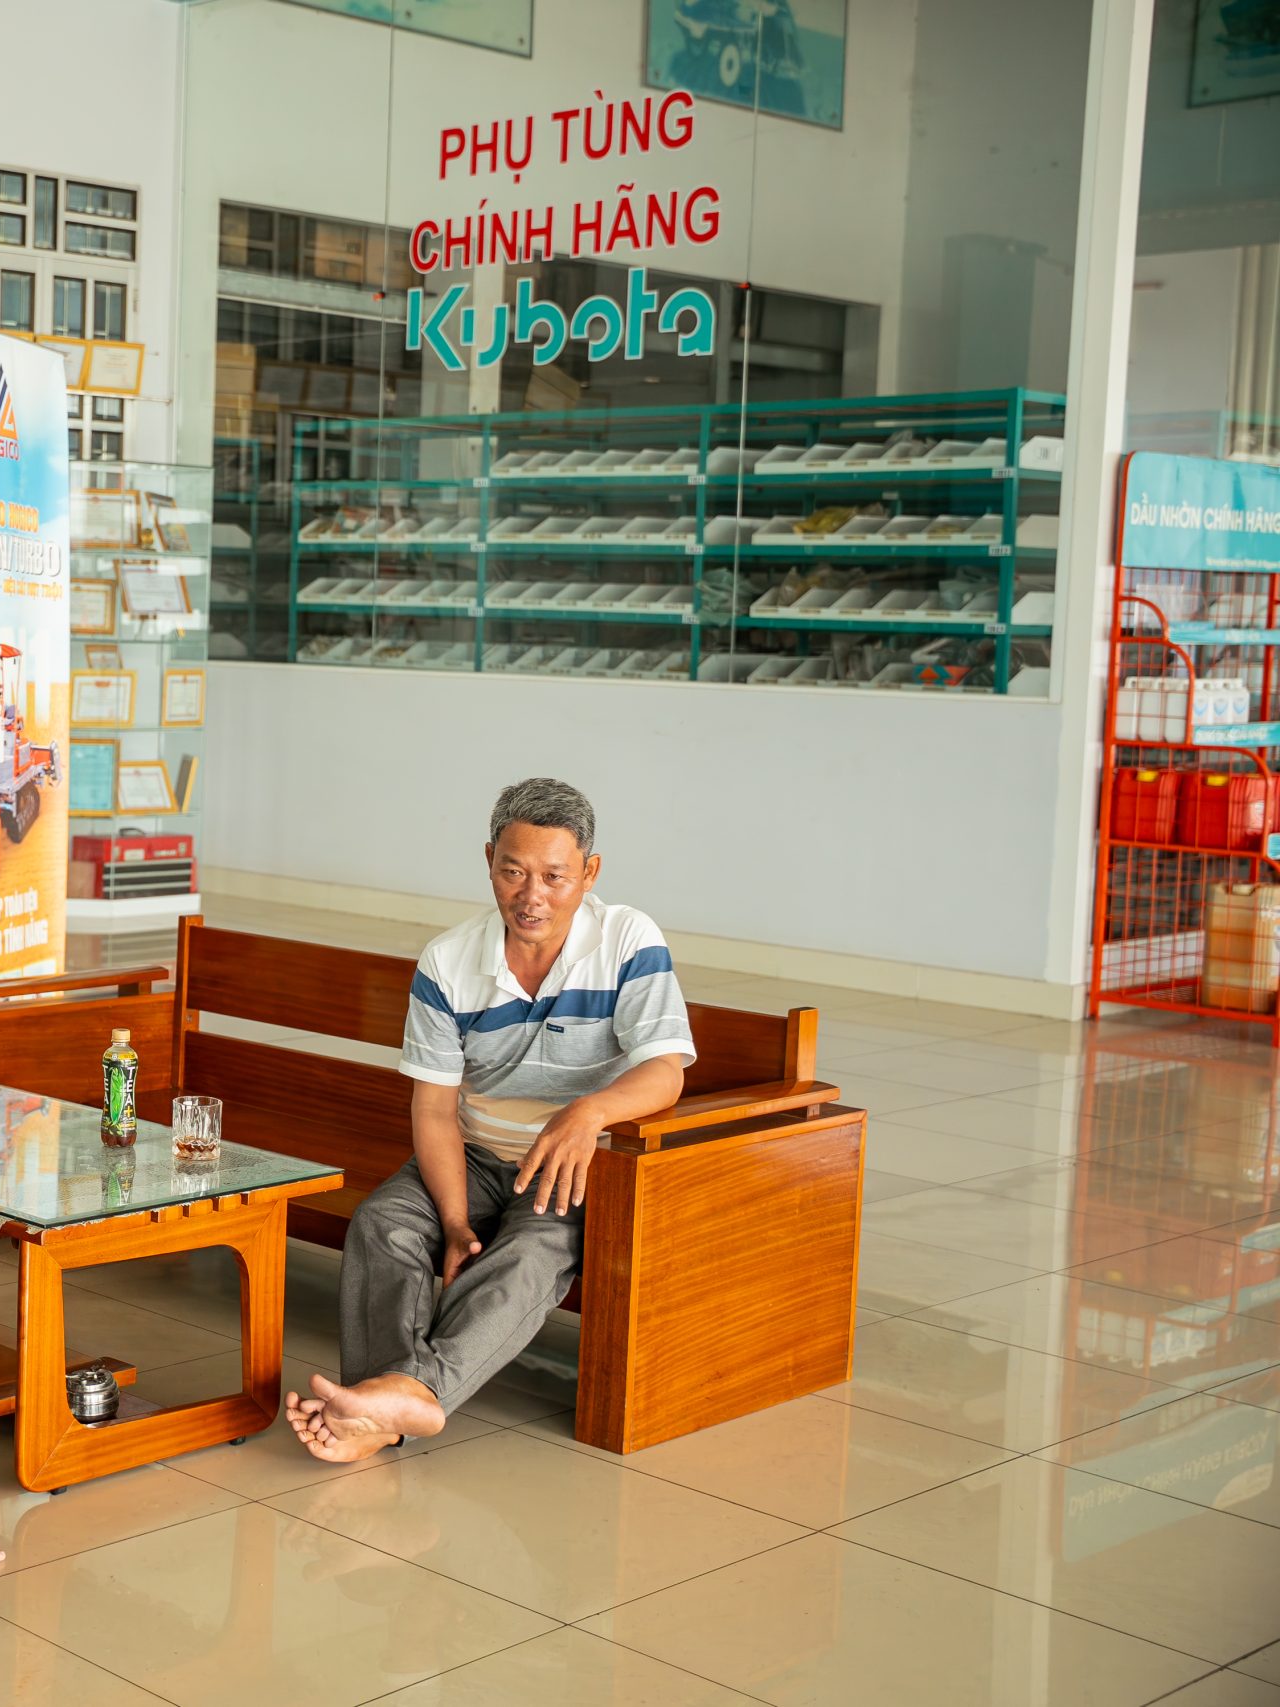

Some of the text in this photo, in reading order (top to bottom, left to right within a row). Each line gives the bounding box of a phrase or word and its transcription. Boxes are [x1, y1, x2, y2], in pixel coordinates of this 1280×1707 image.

[439, 89, 694, 183] PHỤ TÙNG
[410, 183, 720, 273] CHÍNH HÃNG
[406, 267, 715, 371] Kubota
[1130, 491, 1280, 534] DẦU NHỜN CHÍNH HÃNG
